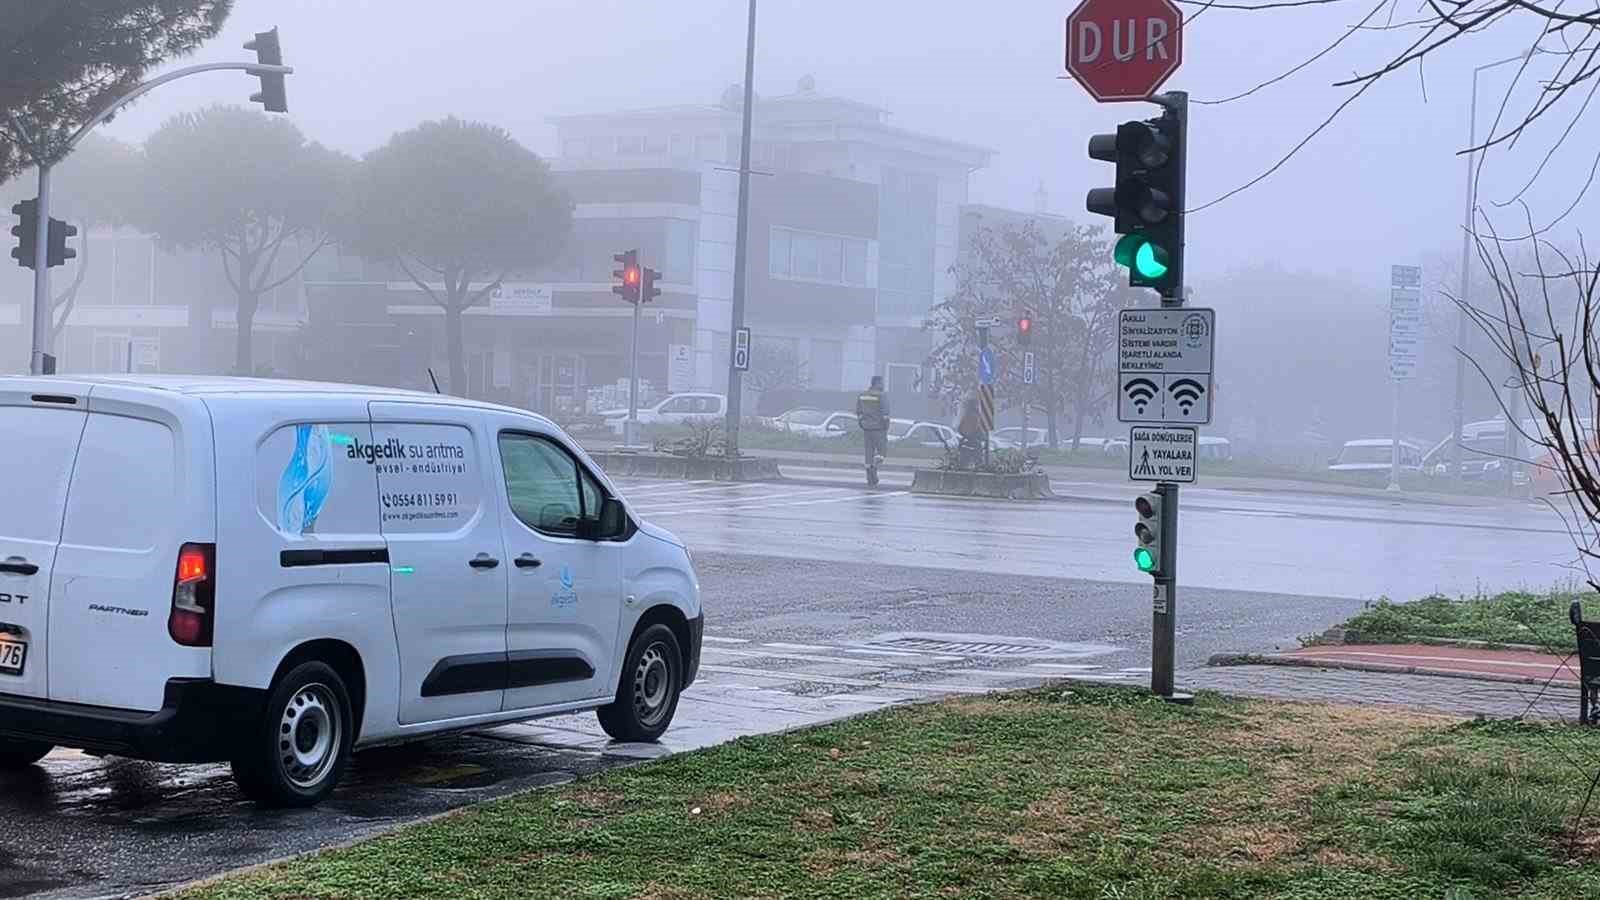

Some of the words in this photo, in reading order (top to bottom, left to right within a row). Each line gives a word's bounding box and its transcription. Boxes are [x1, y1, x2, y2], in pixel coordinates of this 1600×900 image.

[1079, 17, 1168, 63] DUR
[1153, 351, 1183, 359] ALANDA
[1134, 432, 1150, 441] SAĞA
[1152, 432, 1192, 444] DÖNÜŞLERDE
[347, 438, 406, 464] akgedik
[408, 445, 423, 459] su
[1153, 449, 1193, 460] YAYALARA
[376, 463, 404, 474] evsel
[412, 463, 466, 475] endüstriyel
[1159, 465, 1173, 475] YOL
[1176, 466, 1192, 477] VER
[88, 603, 149, 617] PARTNER
